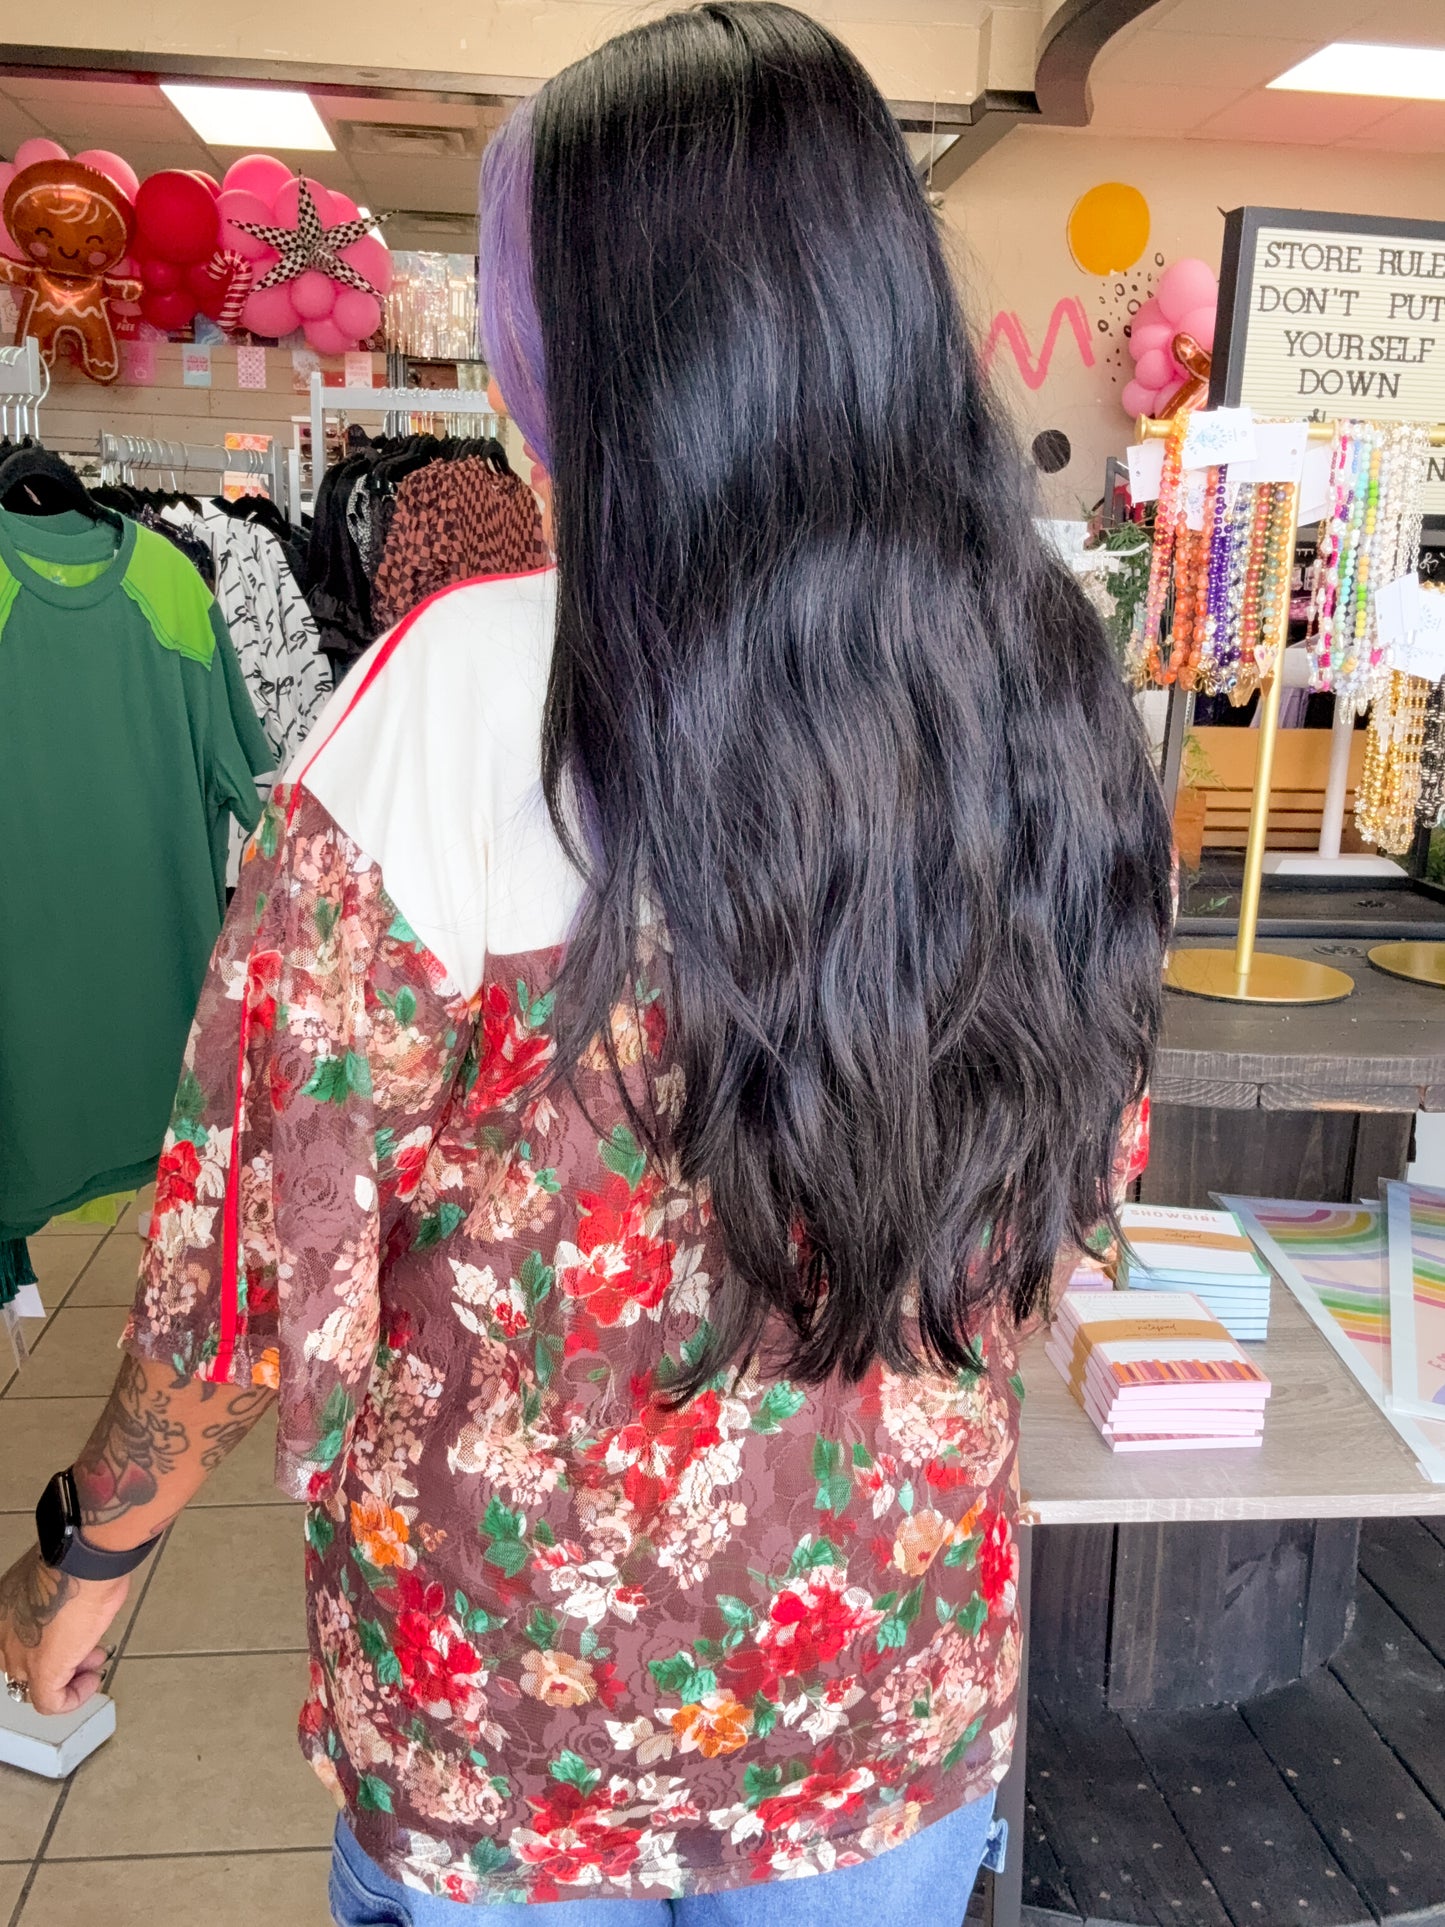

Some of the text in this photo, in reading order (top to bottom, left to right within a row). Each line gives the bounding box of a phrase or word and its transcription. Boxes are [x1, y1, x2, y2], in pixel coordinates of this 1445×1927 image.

[1264, 240, 1363, 274] STORE
[1257, 284, 1445, 323] DON'T PUT
[1283, 329, 1436, 364] YOURSELF
[1297, 368, 1401, 399] DOWN
[1129, 1209, 1219, 1223] SHOWGIRL
